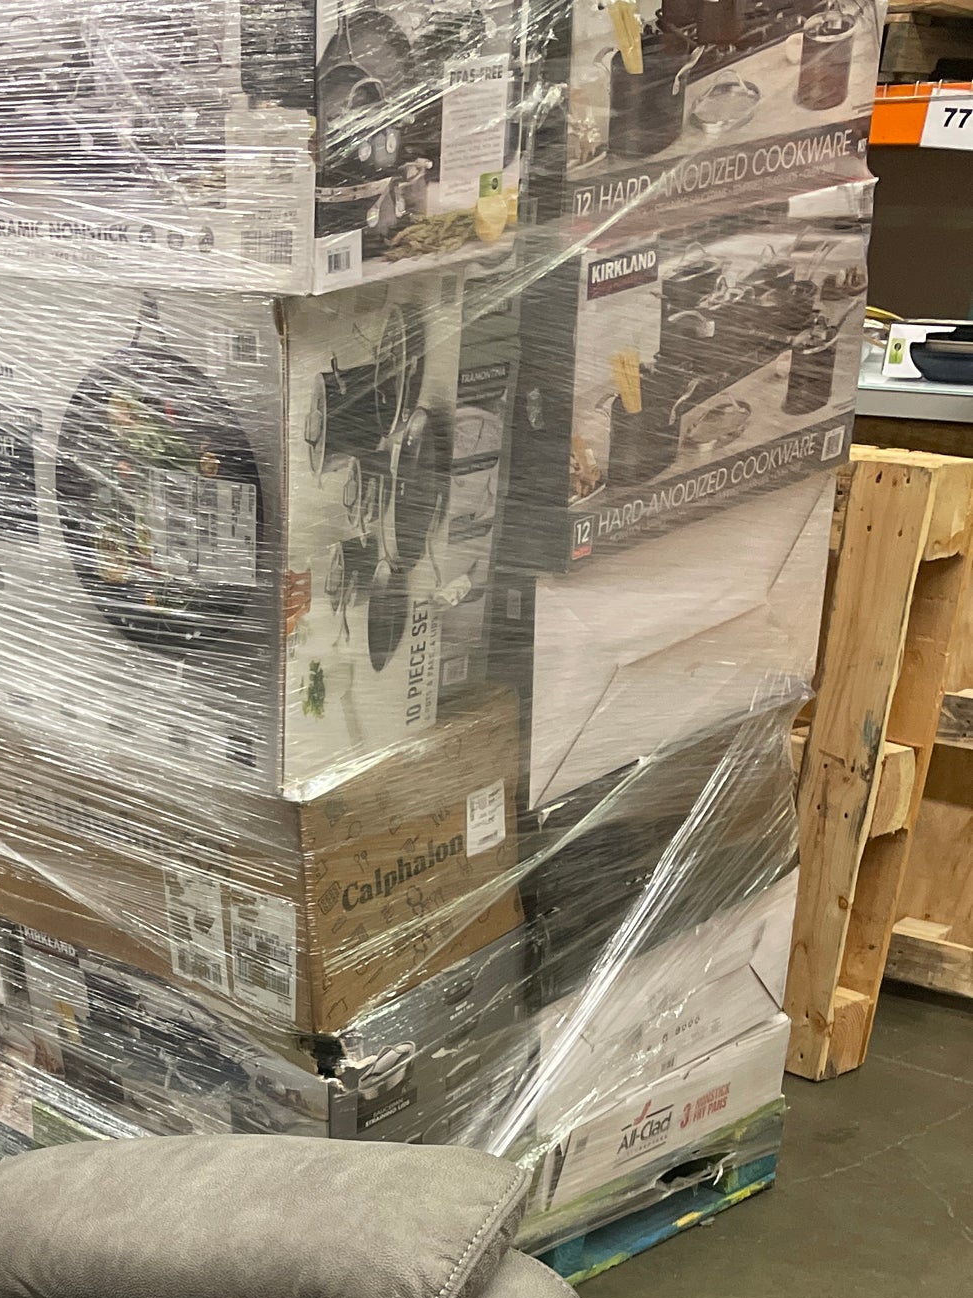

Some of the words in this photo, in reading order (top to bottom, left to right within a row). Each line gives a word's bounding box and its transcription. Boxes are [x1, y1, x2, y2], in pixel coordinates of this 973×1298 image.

[751, 129, 852, 176] COOKWARE
[591, 250, 657, 284] KIRKLAND
[576, 520, 591, 545] 12
[598, 467, 728, 537] HARD-ANODIZED
[730, 433, 819, 485] COOKWARE
[411, 600, 429, 638] SET
[407, 640, 427, 700] PIECE
[405, 703, 422, 727] 10
[342, 833, 465, 914] Calphalon
[617, 1109, 673, 1154] All-Clad
[680, 1103, 692, 1129] 3
